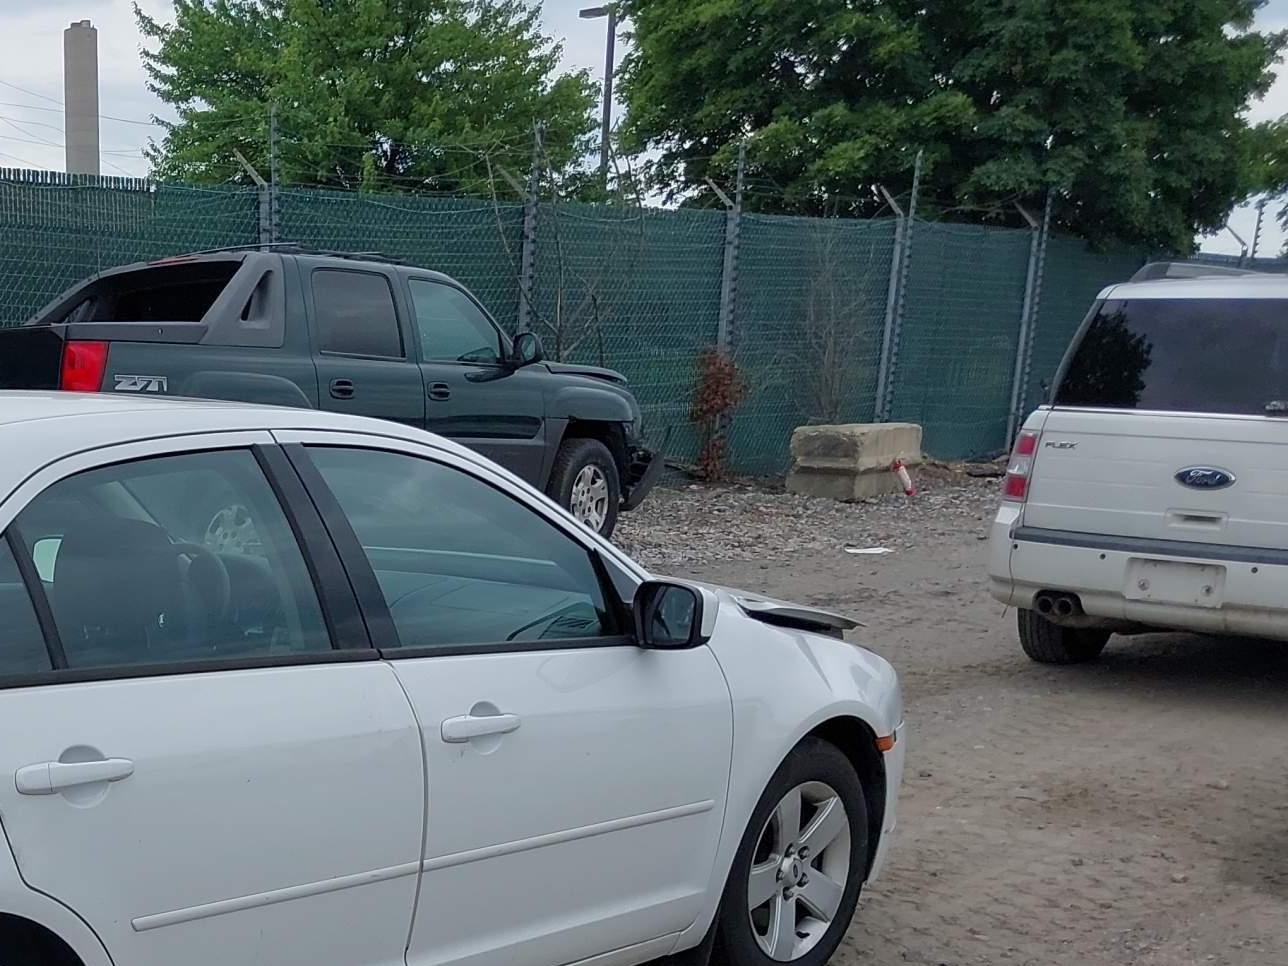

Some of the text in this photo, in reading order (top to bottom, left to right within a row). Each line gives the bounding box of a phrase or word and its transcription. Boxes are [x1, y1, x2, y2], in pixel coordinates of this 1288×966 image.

[114, 374, 168, 392] Z71
[1045, 441, 1080, 449] FLEX
[1186, 469, 1222, 485] Ford
